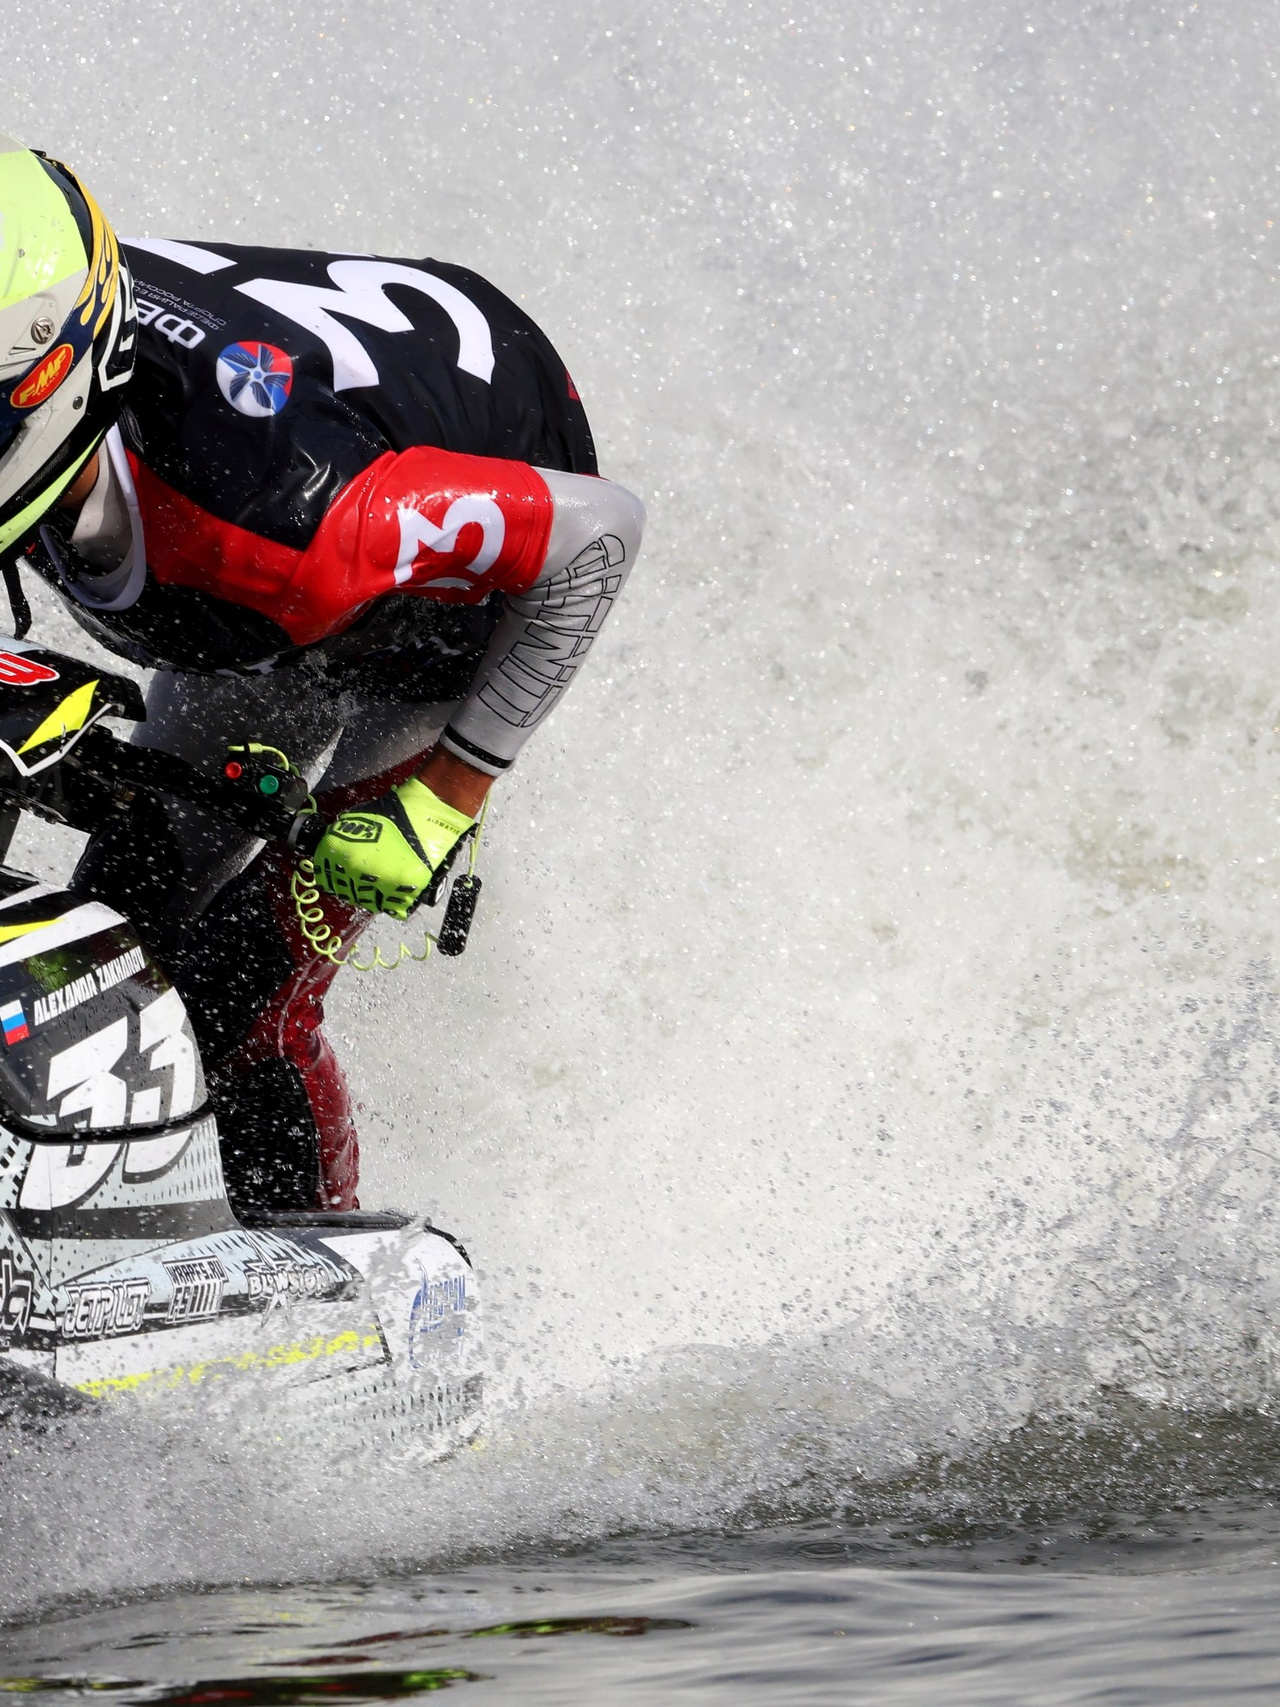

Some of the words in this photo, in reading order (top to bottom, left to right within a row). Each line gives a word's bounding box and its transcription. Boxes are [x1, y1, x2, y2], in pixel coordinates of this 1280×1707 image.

[19, 348, 67, 405] FMF
[337, 821, 376, 838] 100%
[34, 973, 98, 1026] ALEXANDR
[95, 945, 146, 992] ZAKHAROV
[20, 986, 195, 1210] 33
[62, 1278, 152, 1338] JETPILOT
